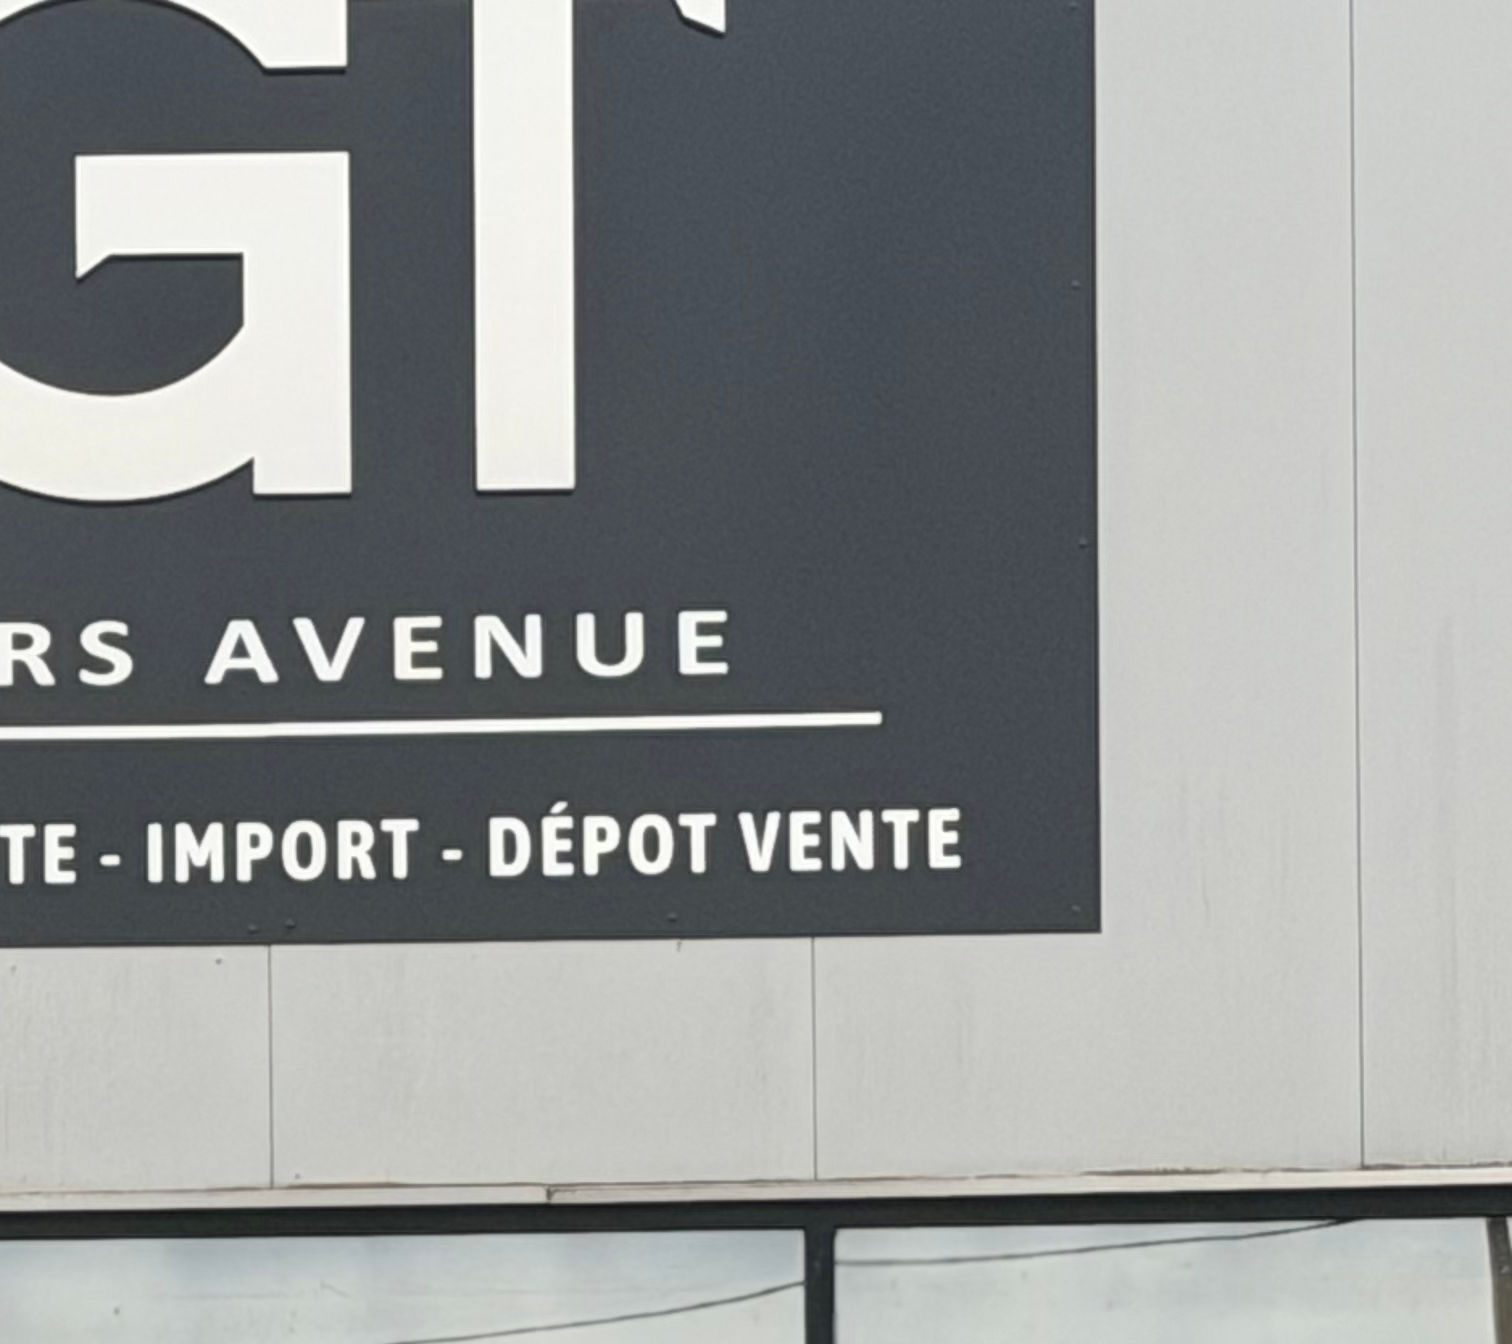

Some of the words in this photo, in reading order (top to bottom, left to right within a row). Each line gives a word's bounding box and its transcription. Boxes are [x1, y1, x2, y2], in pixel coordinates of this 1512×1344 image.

[204, 610, 730, 686] AVENUE
[146, 818, 421, 884] IMPORT
[488, 801, 717, 878] DÉPOT
[738, 807, 963, 873] VENTE
